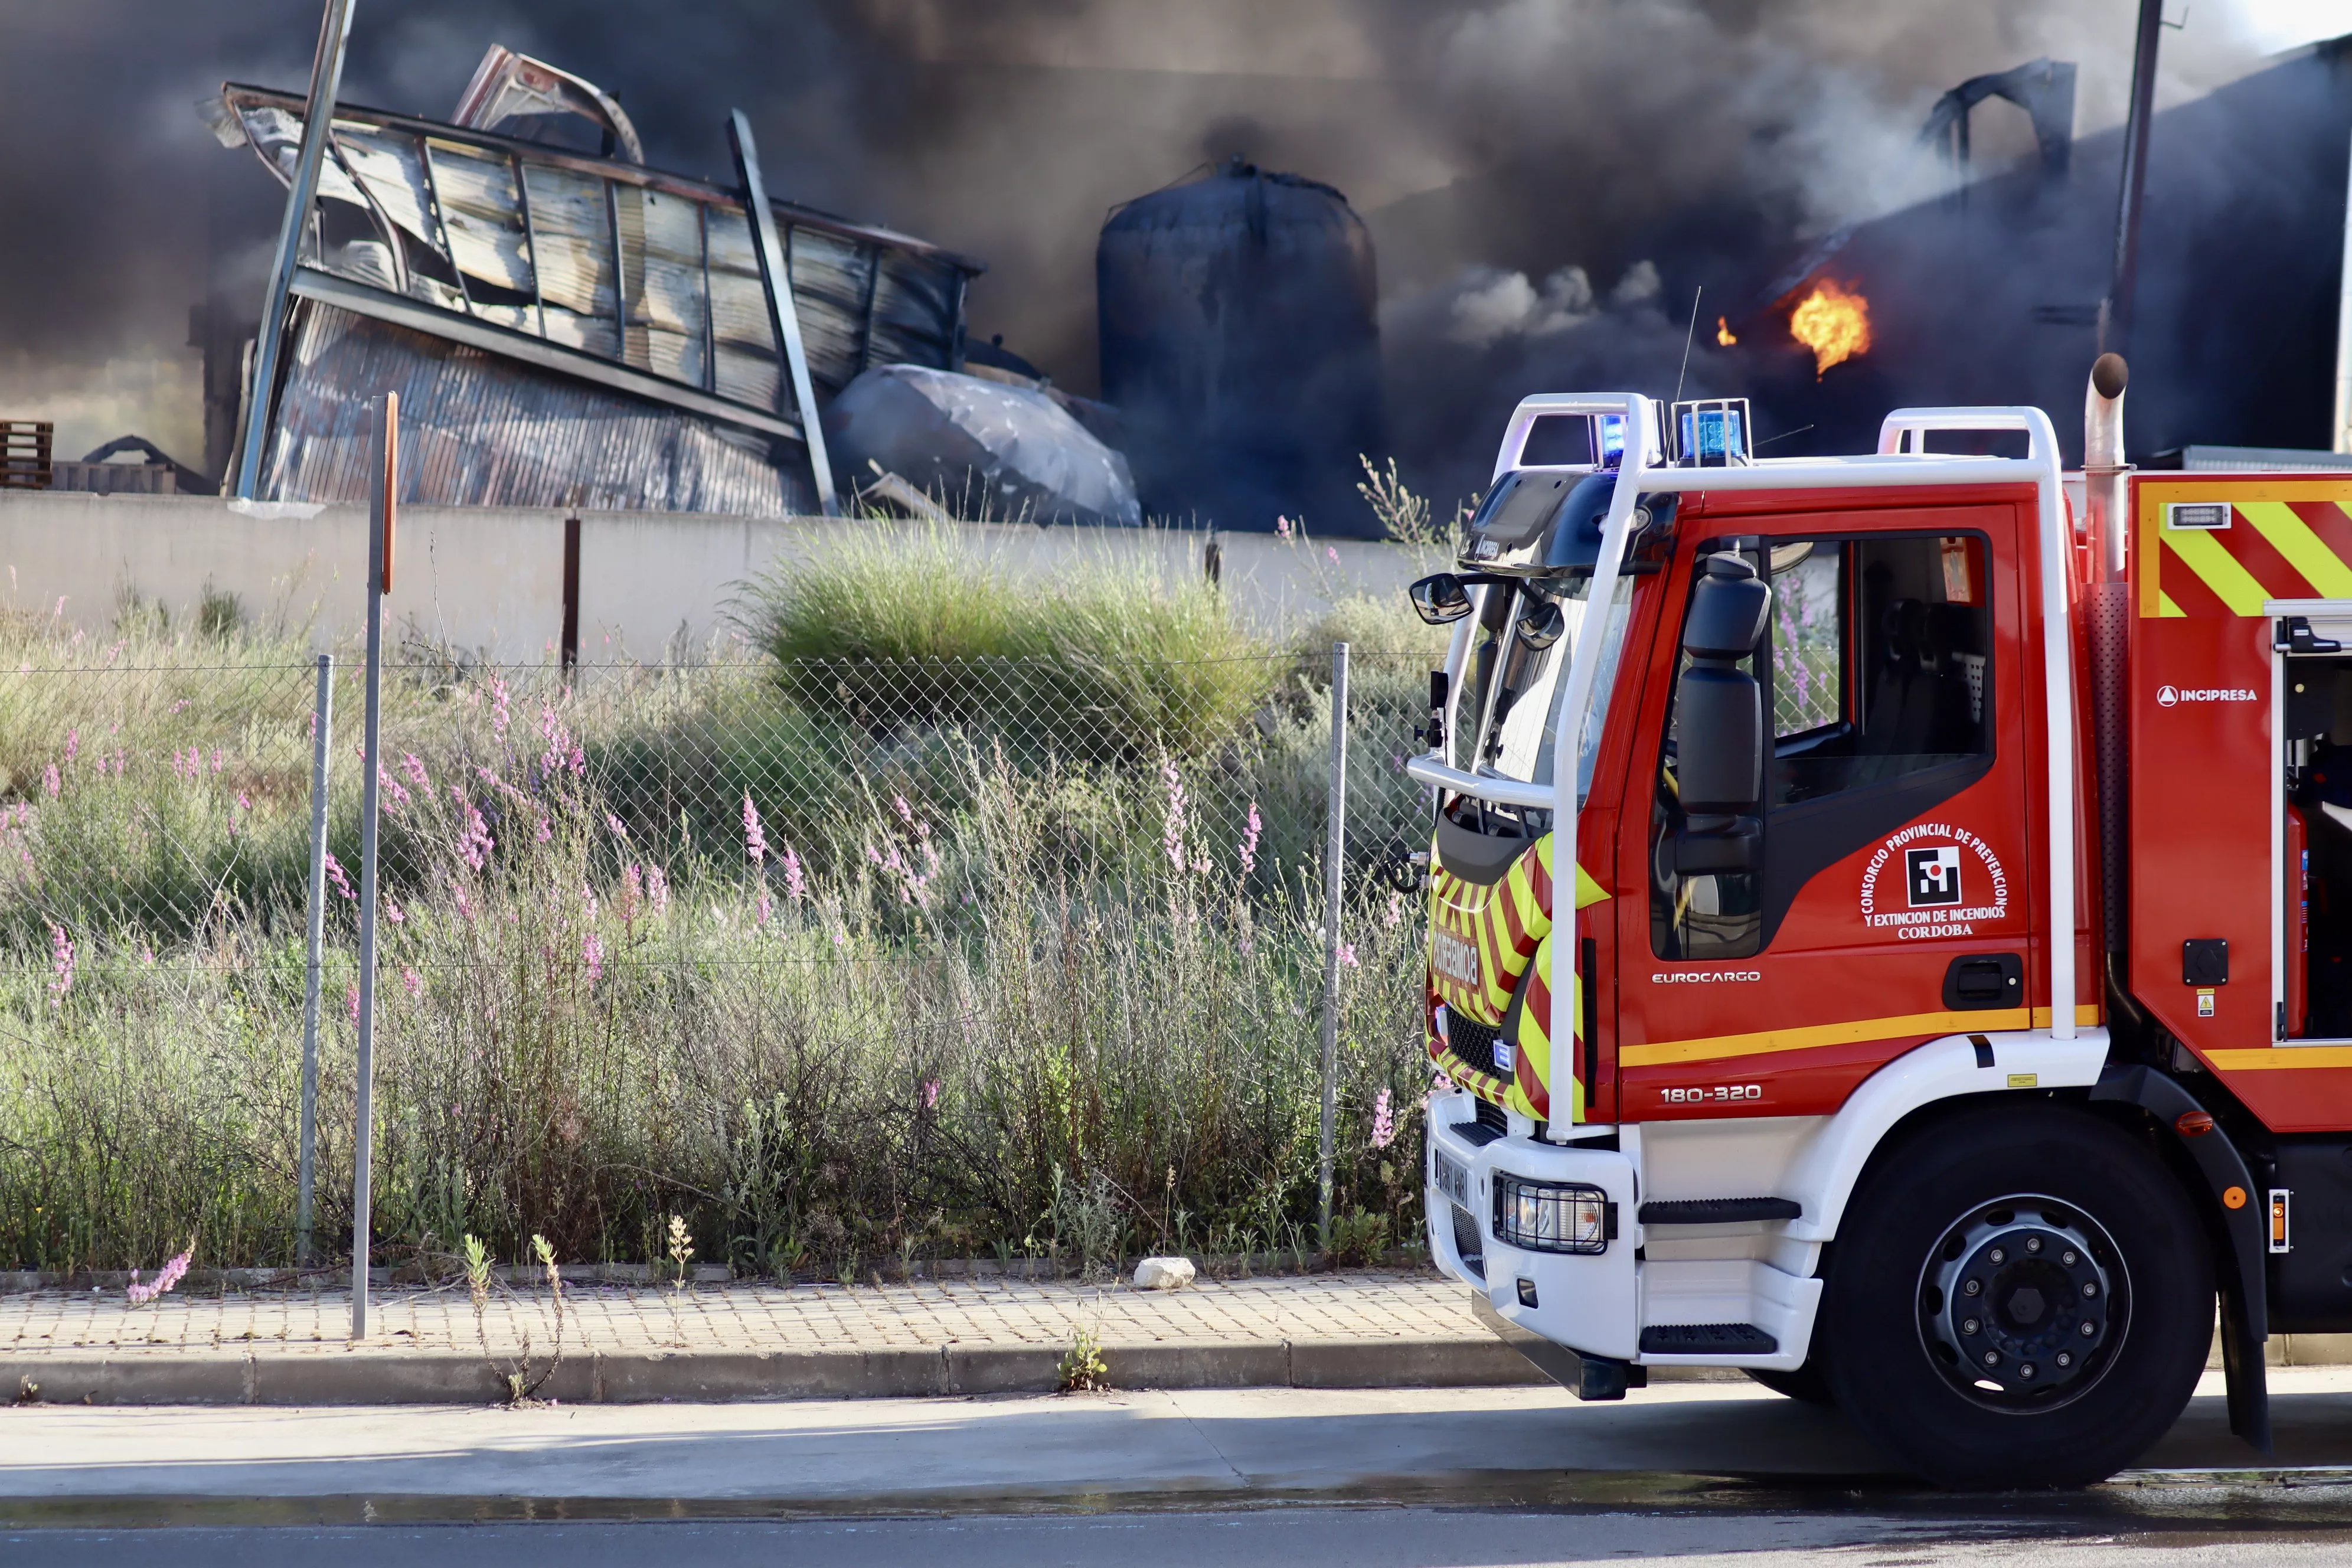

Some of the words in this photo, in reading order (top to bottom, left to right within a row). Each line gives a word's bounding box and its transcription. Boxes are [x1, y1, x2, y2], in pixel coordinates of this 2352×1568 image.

[2181, 689, 2258, 701] INCIPRESA
[1860, 848, 1889, 914] CONSORCIO
[1886, 823, 1952, 852] PROVINCIAL
[1954, 828, 1972, 844] DE
[1969, 837, 2008, 906] PREVENCION
[1864, 914, 1873, 927] Y
[1874, 911, 1930, 927] EXTINCION
[1933, 910, 1948, 923] DE
[1949, 906, 2005, 922] INCENDIOS
[1898, 923, 1974, 940] CORDOBA
[1652, 971, 1761, 984] EUROCARGO
[1661, 1084, 1762, 1103] 180-320
